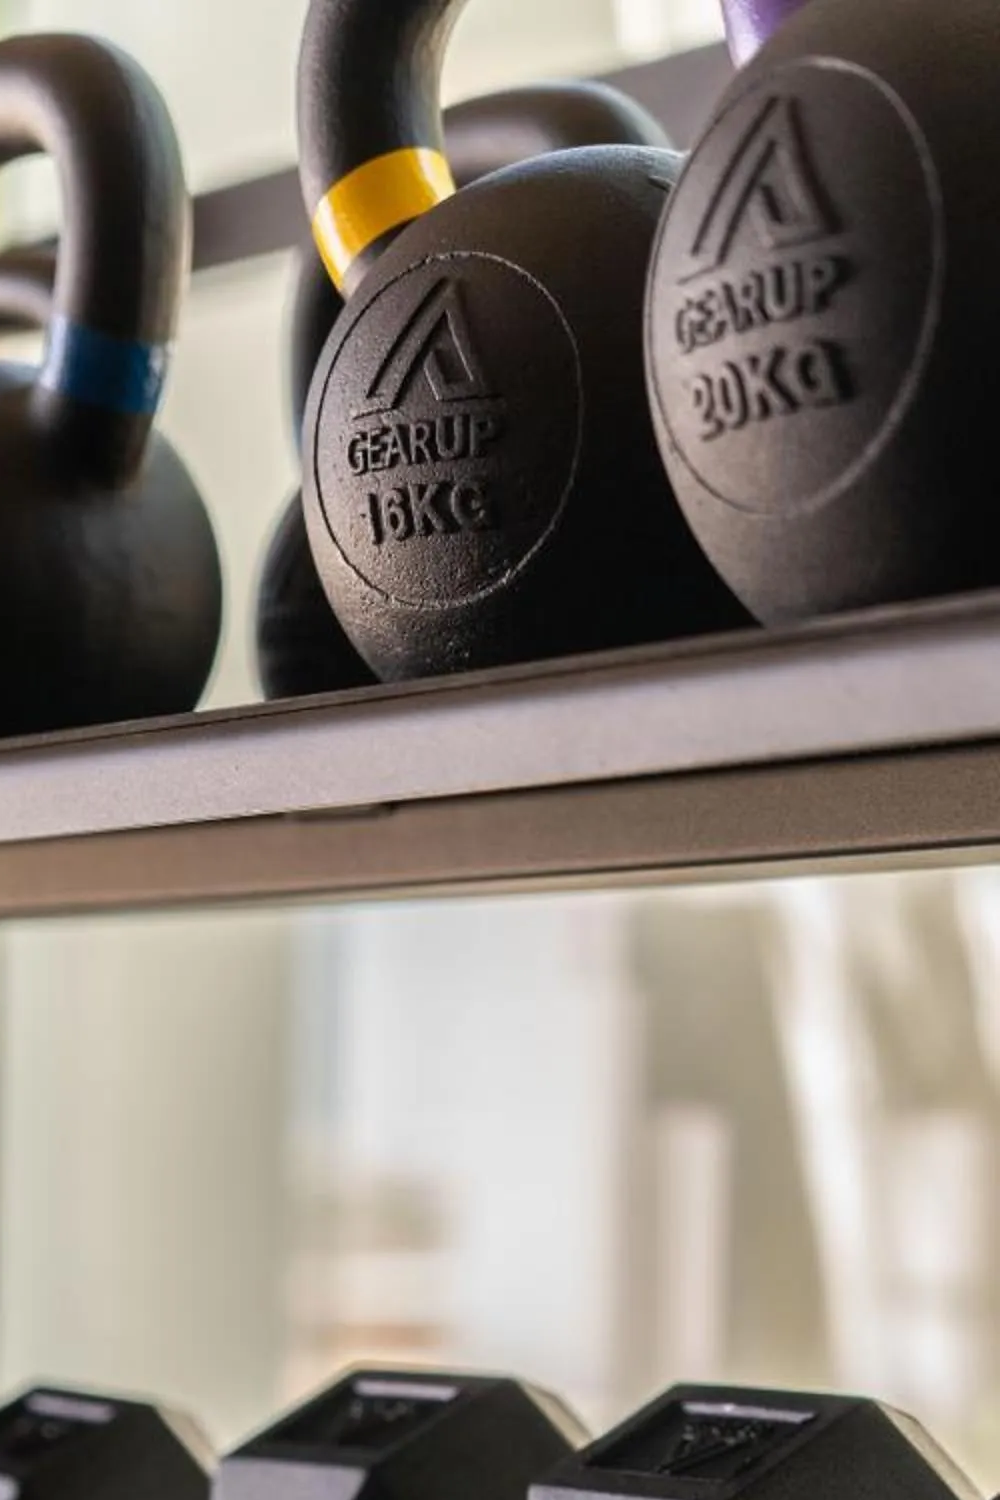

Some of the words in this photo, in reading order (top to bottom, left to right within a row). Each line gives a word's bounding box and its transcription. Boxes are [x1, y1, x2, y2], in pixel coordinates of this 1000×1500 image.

[675, 255, 848, 354] GEARUP
[347, 412, 498, 476] GEARUP
[364, 476, 492, 546] 16KG
